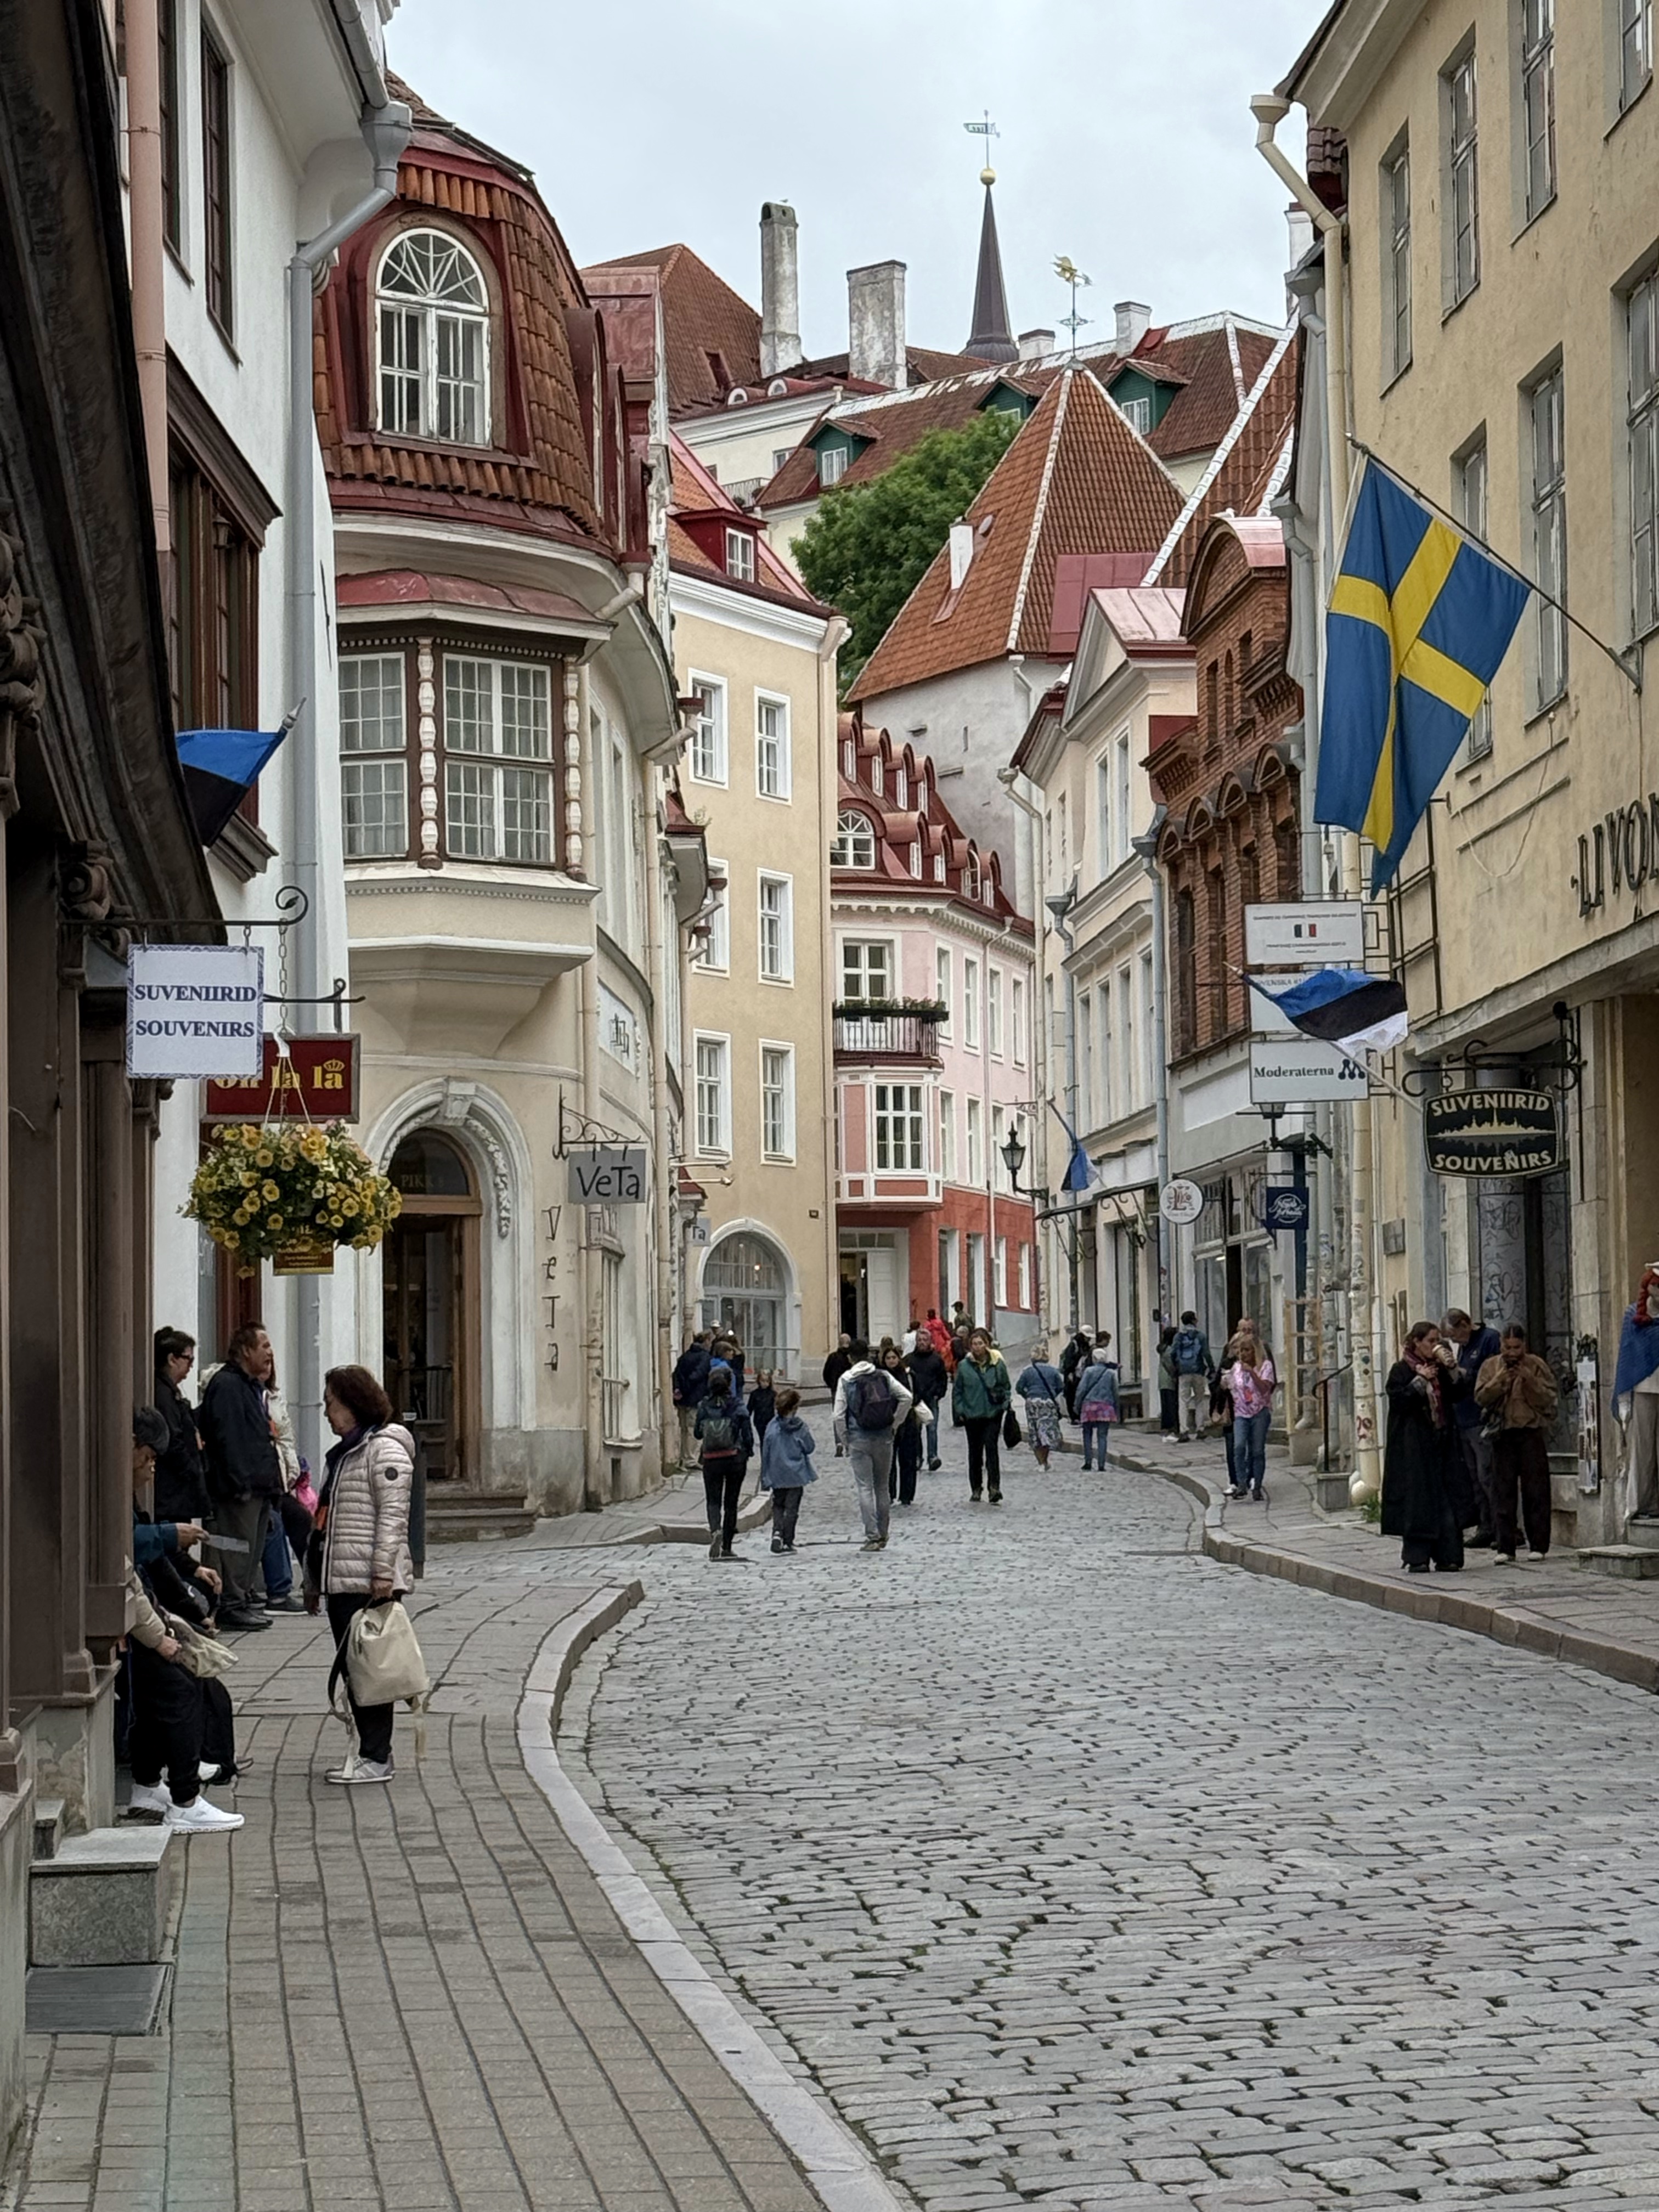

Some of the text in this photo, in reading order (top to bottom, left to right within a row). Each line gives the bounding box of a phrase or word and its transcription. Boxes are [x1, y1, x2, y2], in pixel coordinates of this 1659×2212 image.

[134, 984, 257, 1002] SUVENIIRID
[136, 1020, 255, 1037] SOUVENIRS
[1254, 1066, 1334, 1077] Moderaterna
[1431, 1093, 1549, 1117] SUVENIIRID
[1434, 1150, 1553, 1171] SOUVENIRS
[576, 1165, 640, 1199] VeTa
